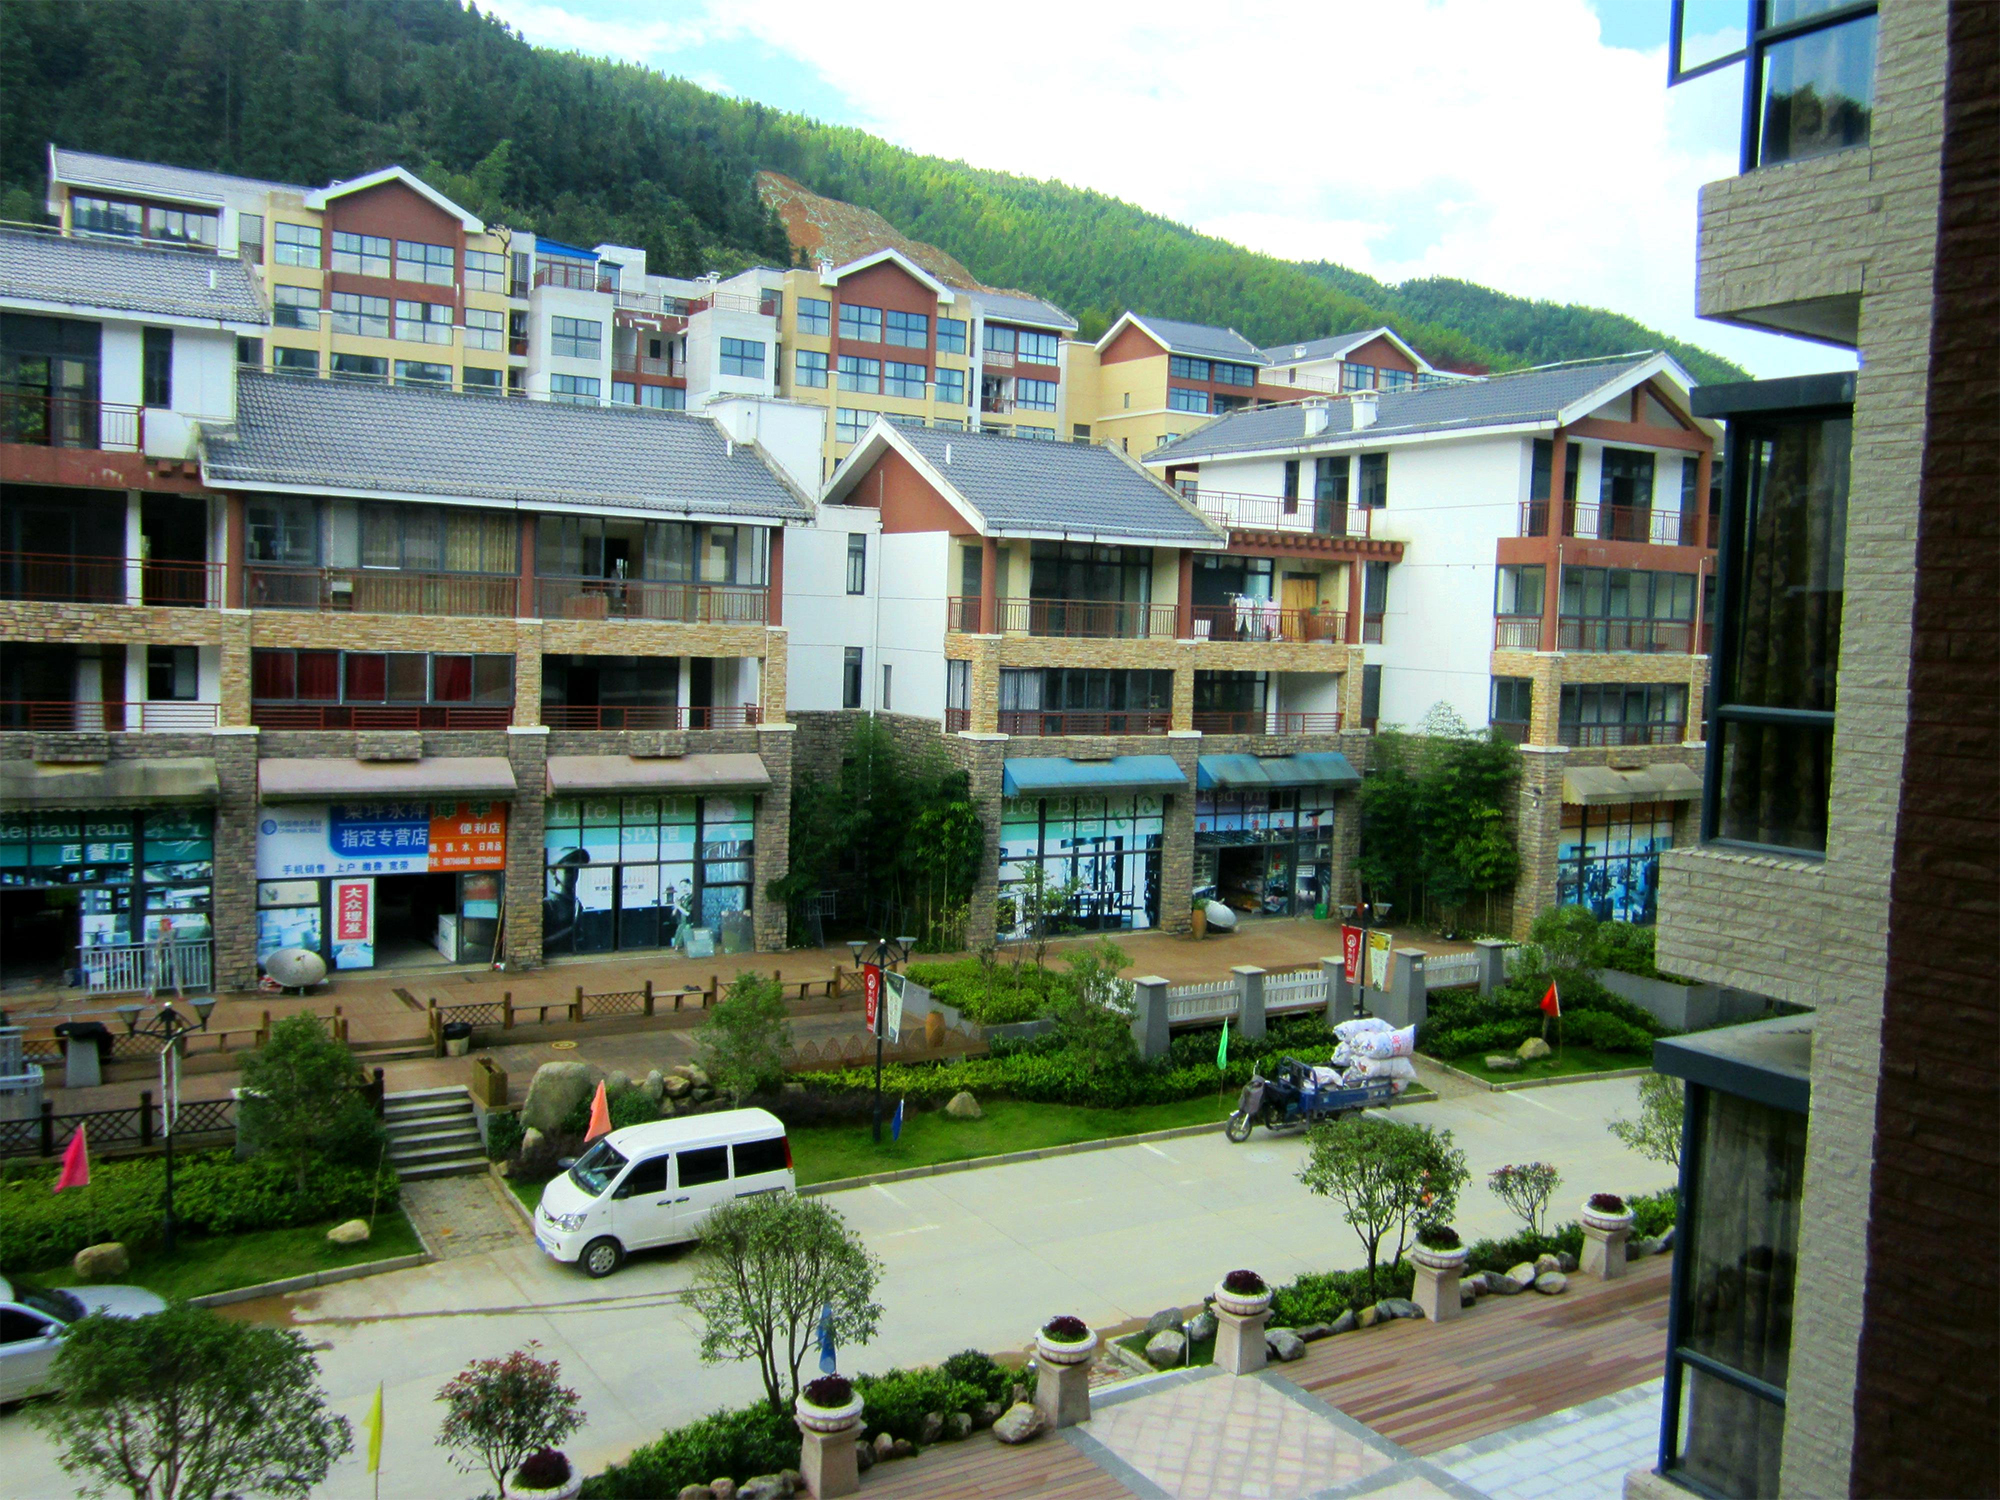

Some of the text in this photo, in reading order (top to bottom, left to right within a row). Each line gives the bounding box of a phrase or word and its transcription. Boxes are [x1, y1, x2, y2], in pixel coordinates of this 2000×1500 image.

[551, 798, 679, 819] Life Hall
[0, 823, 133, 839] estauran
[341, 828, 428, 848] 指定专营店
[460, 822, 502, 835] 便利店
[61, 842, 134, 863] 西餐厅
[345, 887, 363, 934] 大众理发
